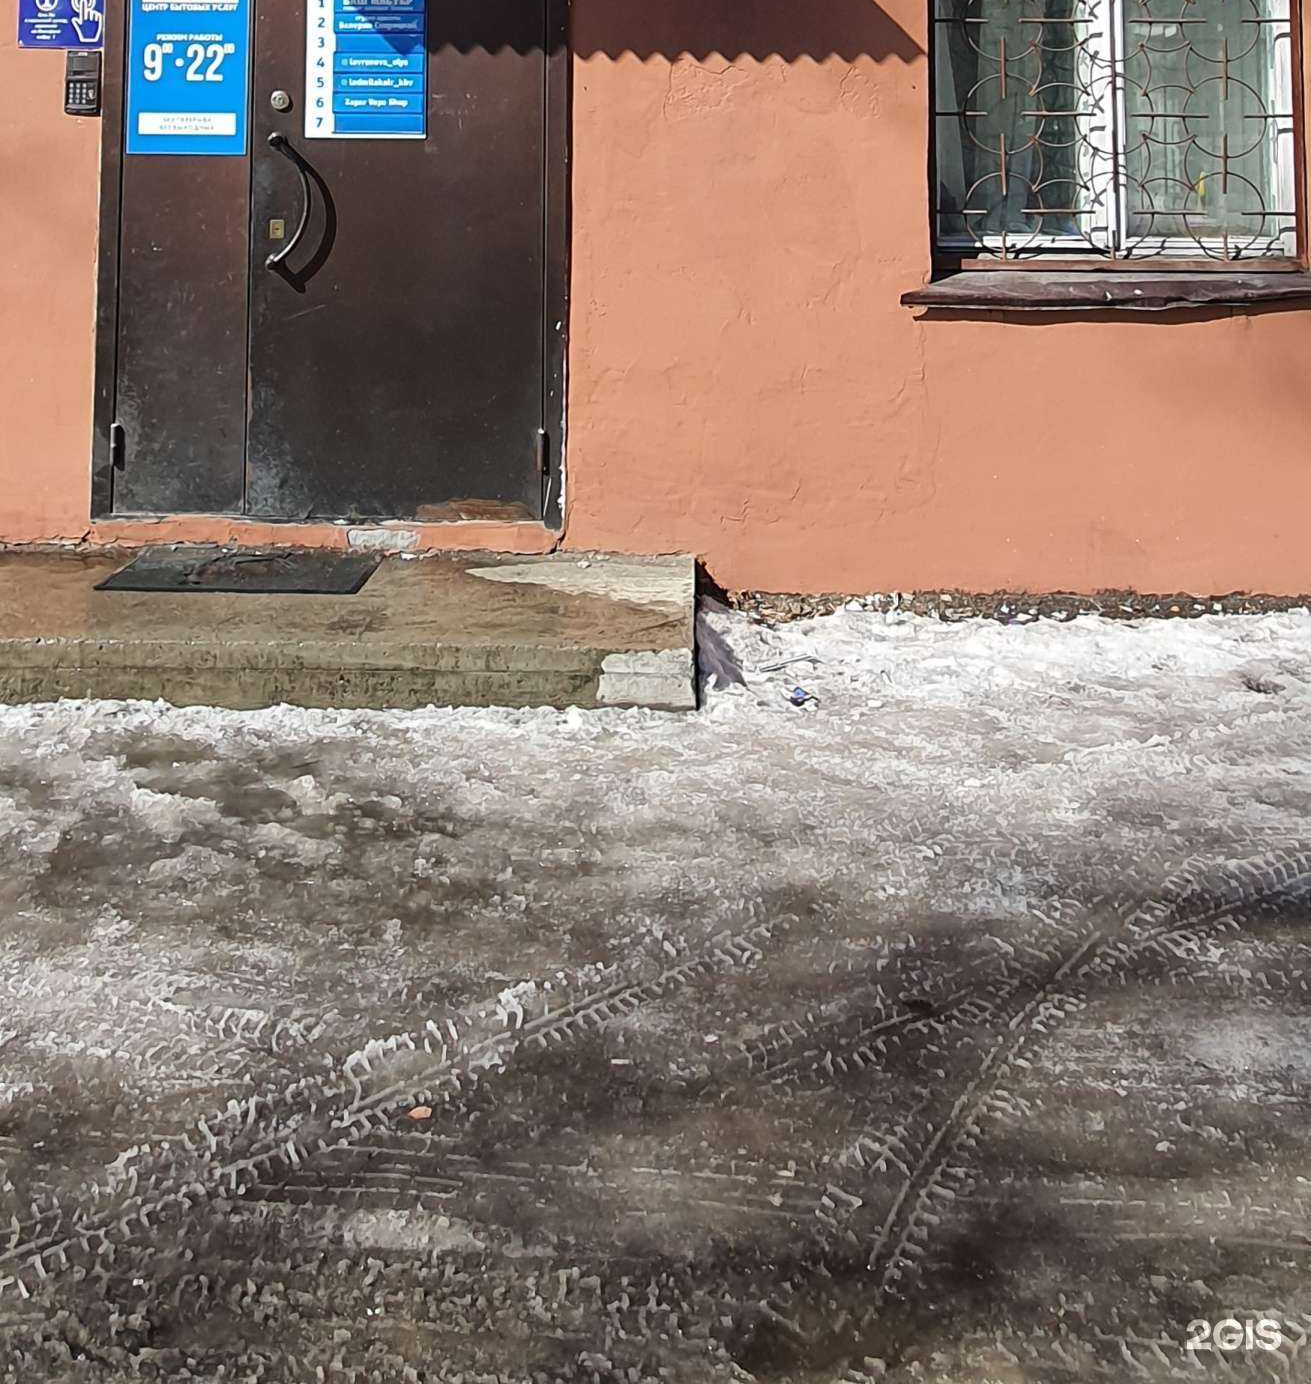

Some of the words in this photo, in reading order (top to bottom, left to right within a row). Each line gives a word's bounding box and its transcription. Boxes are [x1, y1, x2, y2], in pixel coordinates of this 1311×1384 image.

[317, 17, 325, 28] 2
[317, 37, 325, 48] 3
[316, 57, 325, 68] 4
[316, 77, 324, 88] 5
[316, 97, 324, 108] 6
[315, 117, 323, 128] 7
